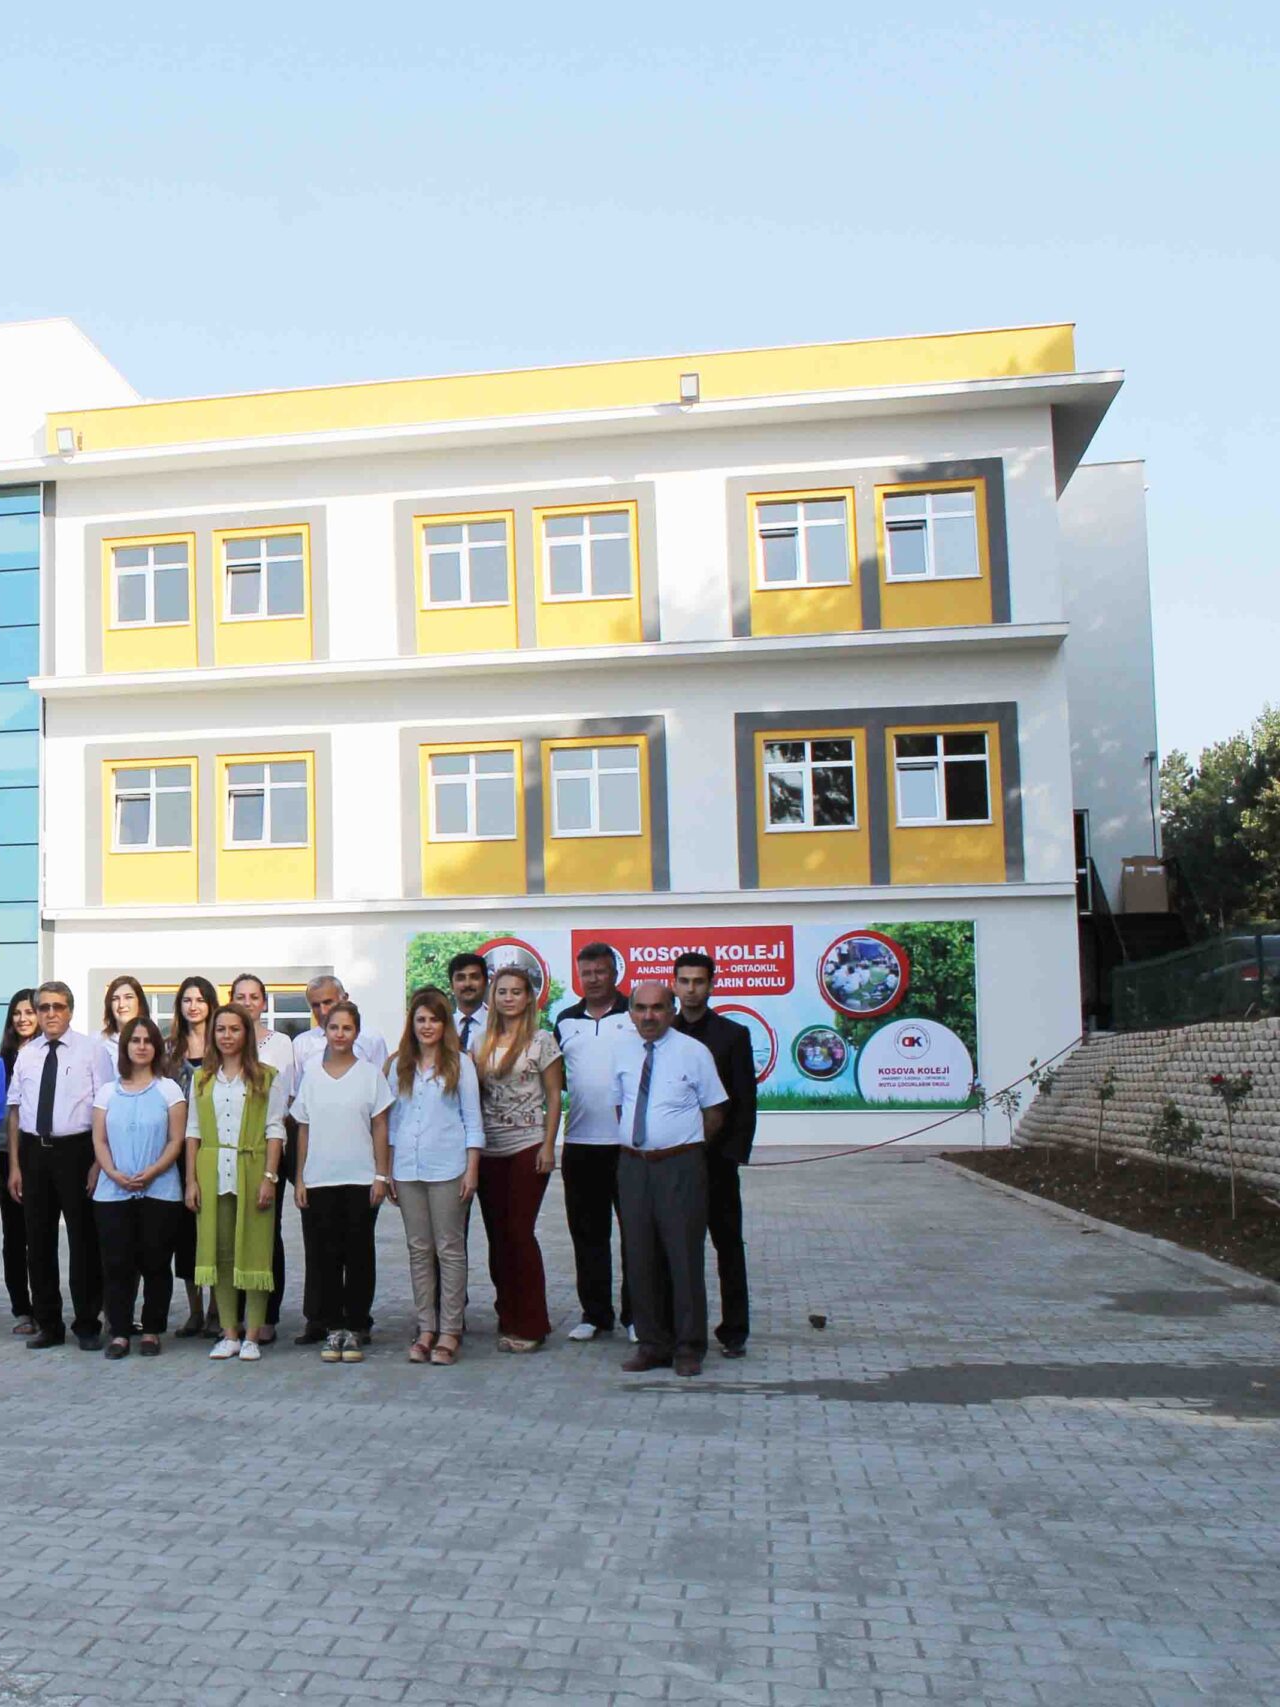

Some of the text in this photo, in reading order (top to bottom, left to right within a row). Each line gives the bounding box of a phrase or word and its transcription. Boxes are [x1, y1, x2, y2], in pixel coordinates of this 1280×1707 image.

[630, 941, 785, 961] KOSOVA KOLEJİ
[636, 965, 674, 975] ANASINI
[730, 964, 779, 973] ORTAOKUL
[746, 977, 786, 988] OKULU
[878, 1066, 950, 1075] KOSOVA KOLEJİ
